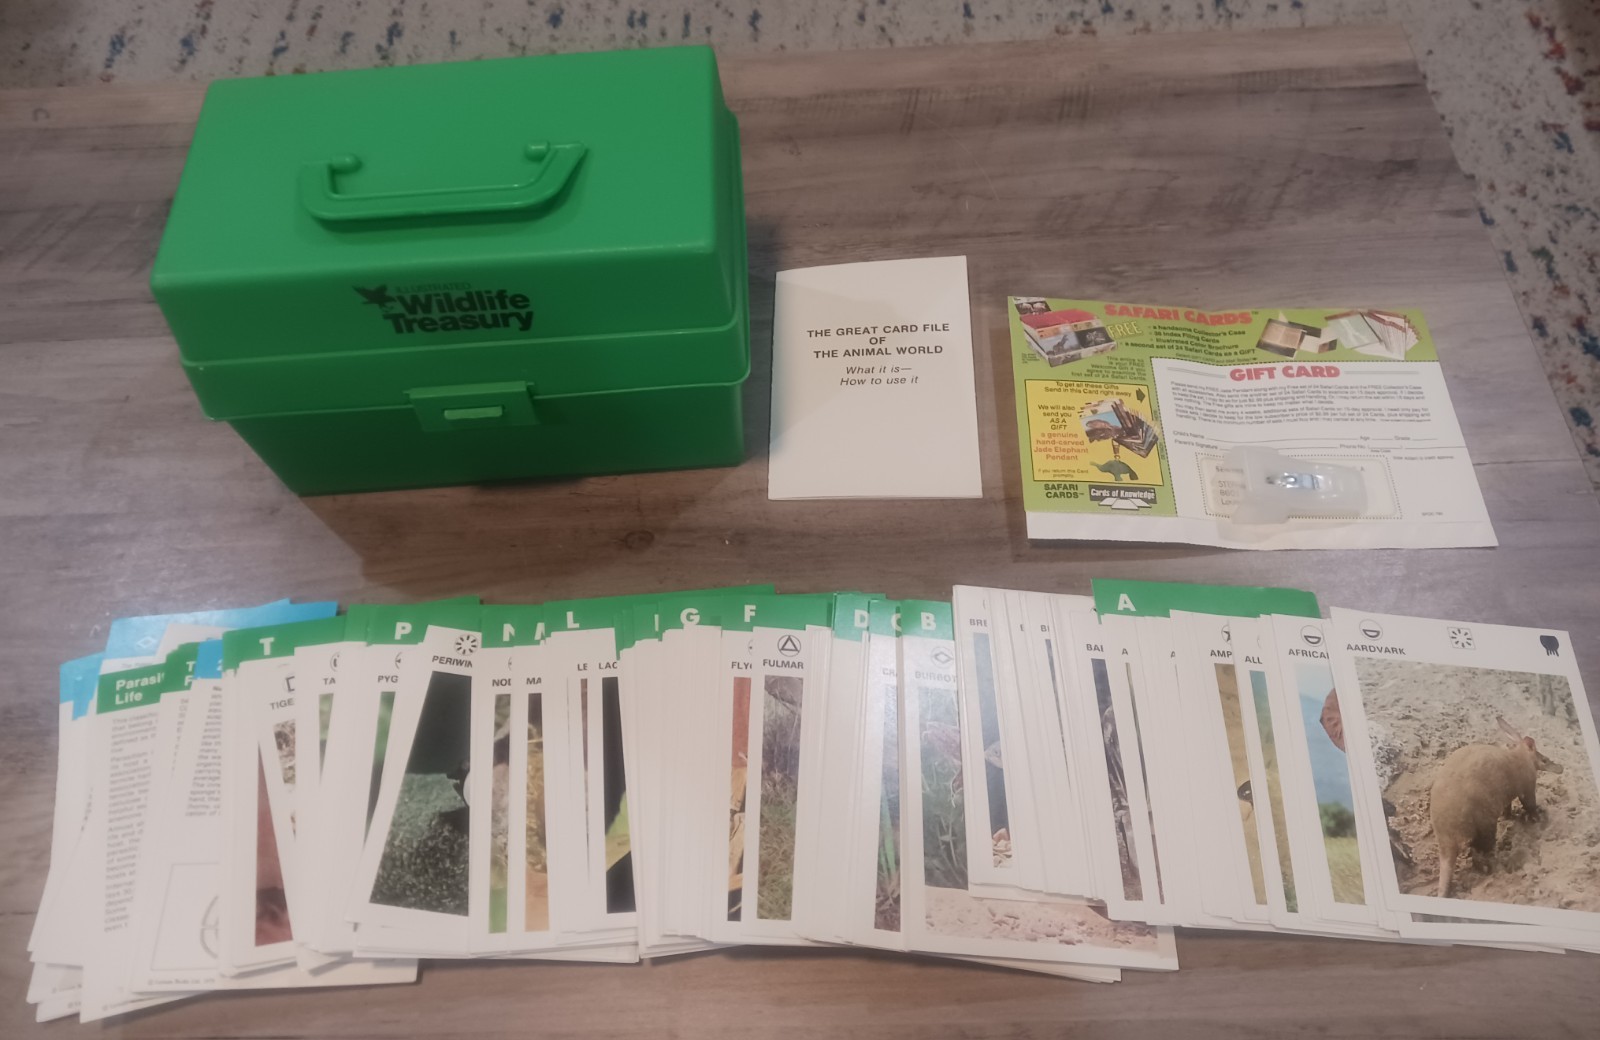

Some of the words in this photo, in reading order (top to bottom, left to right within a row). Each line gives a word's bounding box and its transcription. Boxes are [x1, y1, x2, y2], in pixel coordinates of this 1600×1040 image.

[397, 289, 530, 315] Wildlife
[1104, 304, 1181, 321] SAFARI
[383, 311, 533, 334] Treasury
[807, 329, 831, 338] THE
[836, 326, 878, 336] GREAT
[883, 324, 918, 334] CARD
[923, 323, 950, 332] FILE
[1107, 321, 1142, 338] FREE
[869, 336, 886, 345] OF
[1182, 332, 1200, 341] Filing
[1201, 336, 1220, 344] Cards
[1190, 340, 1207, 348] Color
[814, 350, 839, 358] THE
[843, 347, 892, 357] ANIMAL
[896, 345, 943, 355] WORLD
[846, 366, 874, 374] What
[1230, 367, 1276, 381] GIFT
[1282, 365, 1341, 378] CARD
[840, 377, 866, 386] How
[871, 377, 882, 385] to
[911, 376, 919, 384] it
[1054, 446, 1089, 454] Elephant
[1044, 483, 1078, 491] SAFARI
[1091, 488, 1110, 497] Cards
[1112, 489, 1119, 497] of
[1120, 490, 1156, 499] Knowledge
[1117, 593, 1136, 612] A
[566, 611, 579, 628] L
[680, 608, 700, 626] G
[744, 605, 756, 623] F
[854, 609, 869, 628] D
[920, 612, 937, 631] B
[394, 621, 412, 640] P
[259, 637, 275, 656] T
[1346, 643, 1407, 656] AARDVARK
[1210, 649, 1232, 658] AMP
[577, 663, 588, 671] LE
[599, 661, 618, 670] LAC
[763, 658, 804, 669] FULMAR
[1245, 656, 1263, 665] ALL
[323, 677, 336, 685] TA
[377, 675, 399, 683] PYG
[115, 691, 143, 705] Life
[270, 698, 295, 711] TIGE
